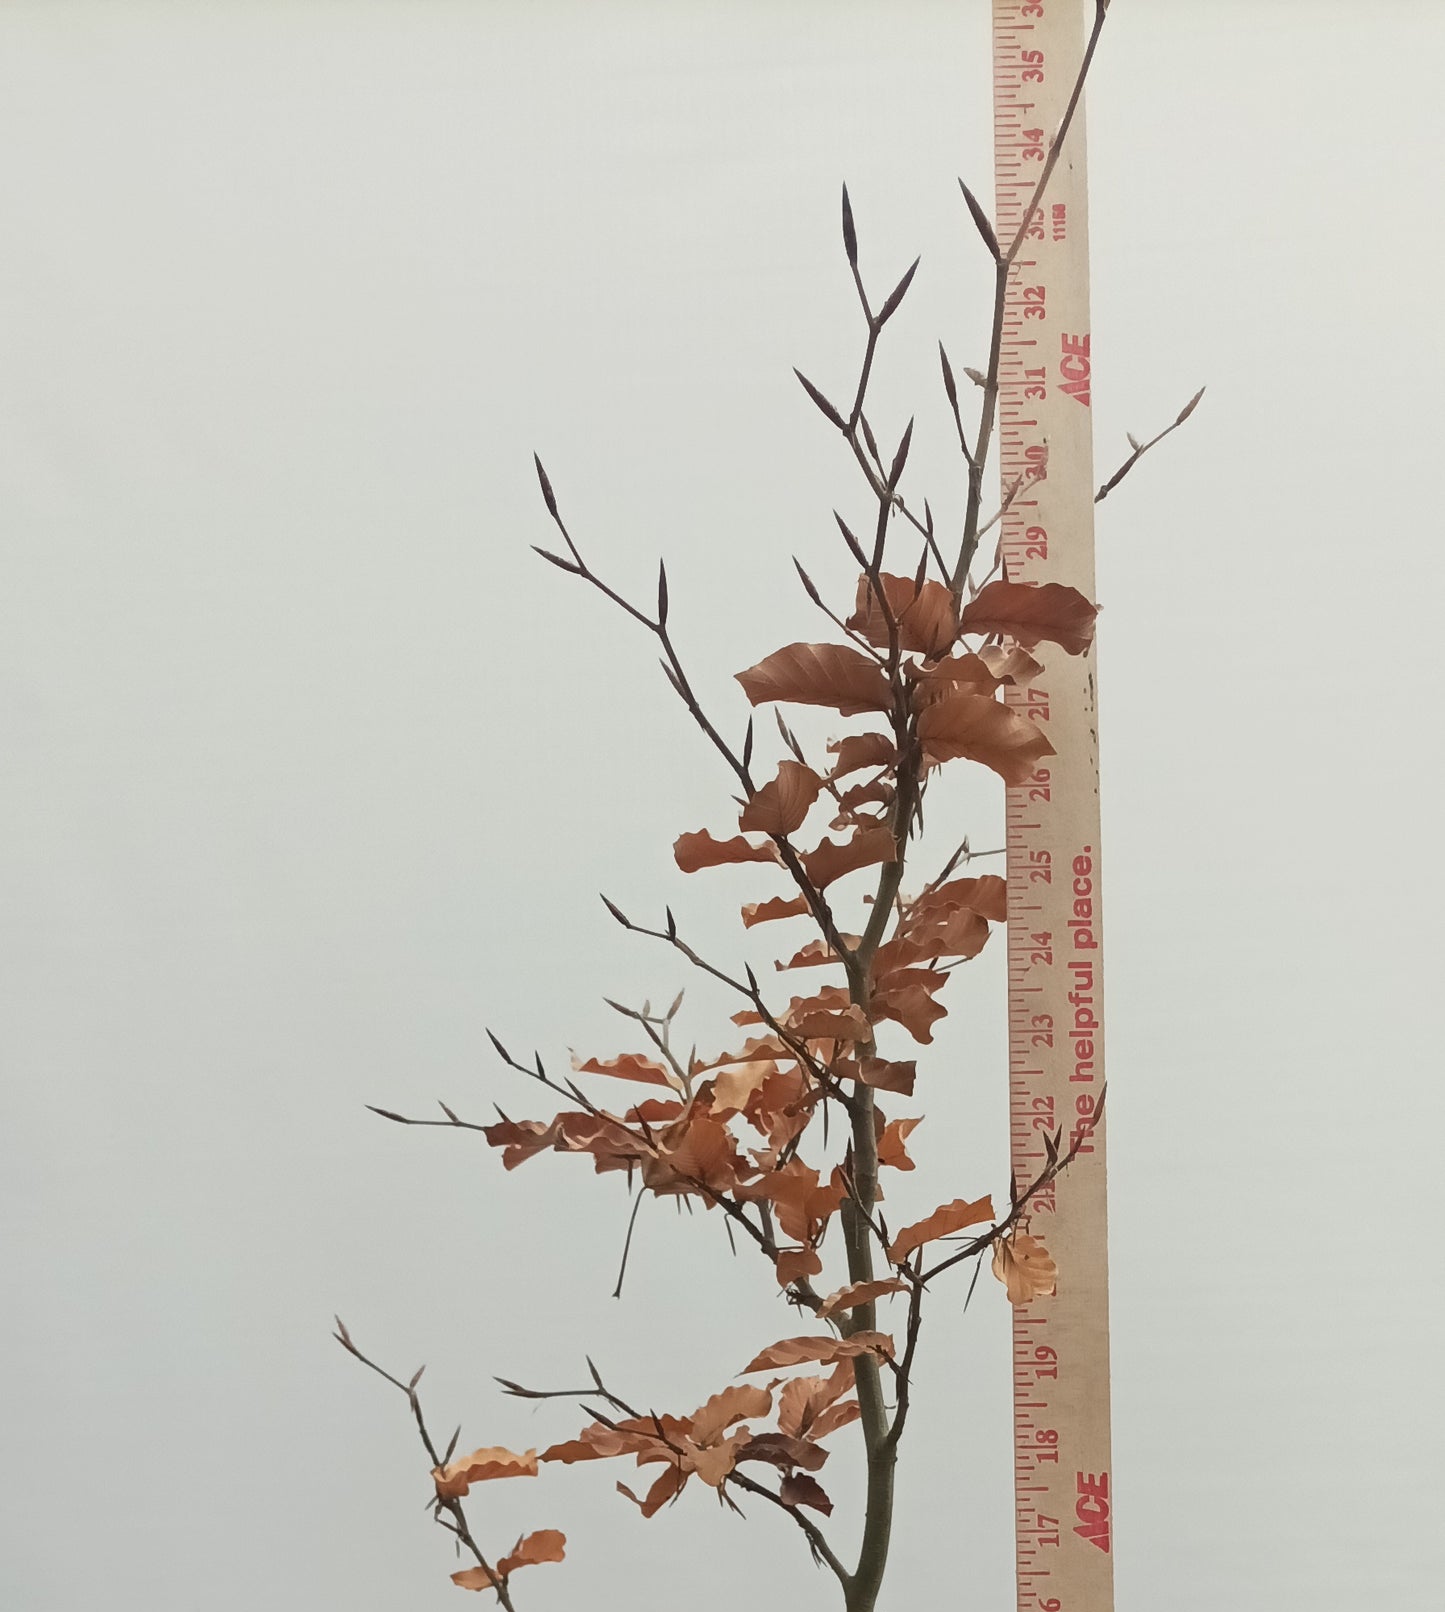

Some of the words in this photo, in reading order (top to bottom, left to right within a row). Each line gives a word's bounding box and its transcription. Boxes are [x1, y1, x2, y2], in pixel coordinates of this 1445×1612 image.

[1022, 0, 1044, 17] 3
[1022, 50, 1044, 83] 35
[1022, 128, 1044, 161] 34
[1024, 286, 1045, 319] 32
[1025, 367, 1046, 400] 31
[1057, 333, 1090, 407] ACE
[1026, 526, 1047, 560] 29
[1028, 688, 1049, 721] 27
[1029, 768, 1050, 802] 26
[1030, 850, 1051, 884] 25
[1068, 846, 1098, 949] place.
[1031, 932, 1052, 965] 24
[1032, 1014, 1054, 1048] 23
[1068, 961, 1099, 1082] helpful
[1033, 1096, 1055, 1131] 22
[1070, 1094, 1094, 1161] The
[1035, 1346, 1058, 1380] 19
[1036, 1429, 1058, 1464] 18
[1073, 1472, 1109, 1553] ACE
[1037, 1514, 1061, 1548] 17
